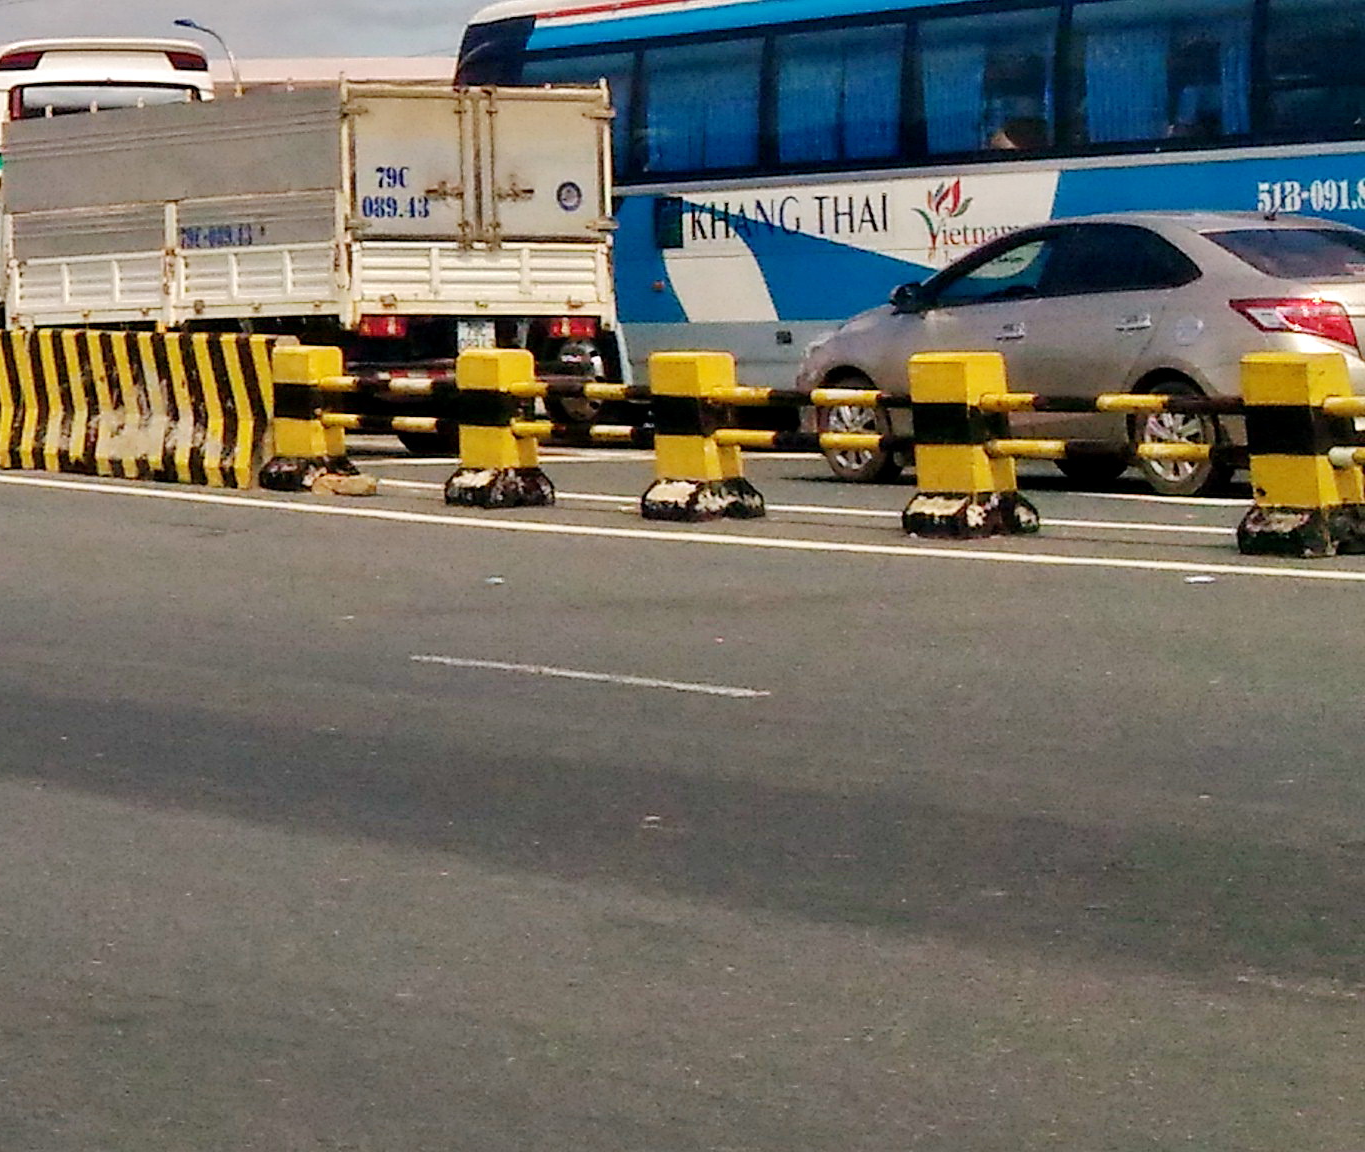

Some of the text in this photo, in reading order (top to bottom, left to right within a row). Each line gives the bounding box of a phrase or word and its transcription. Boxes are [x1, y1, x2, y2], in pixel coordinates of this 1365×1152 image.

[375, 166, 410, 188] 79C
[362, 195, 430, 218] 089.43
[690, 195, 800, 240] KHANG
